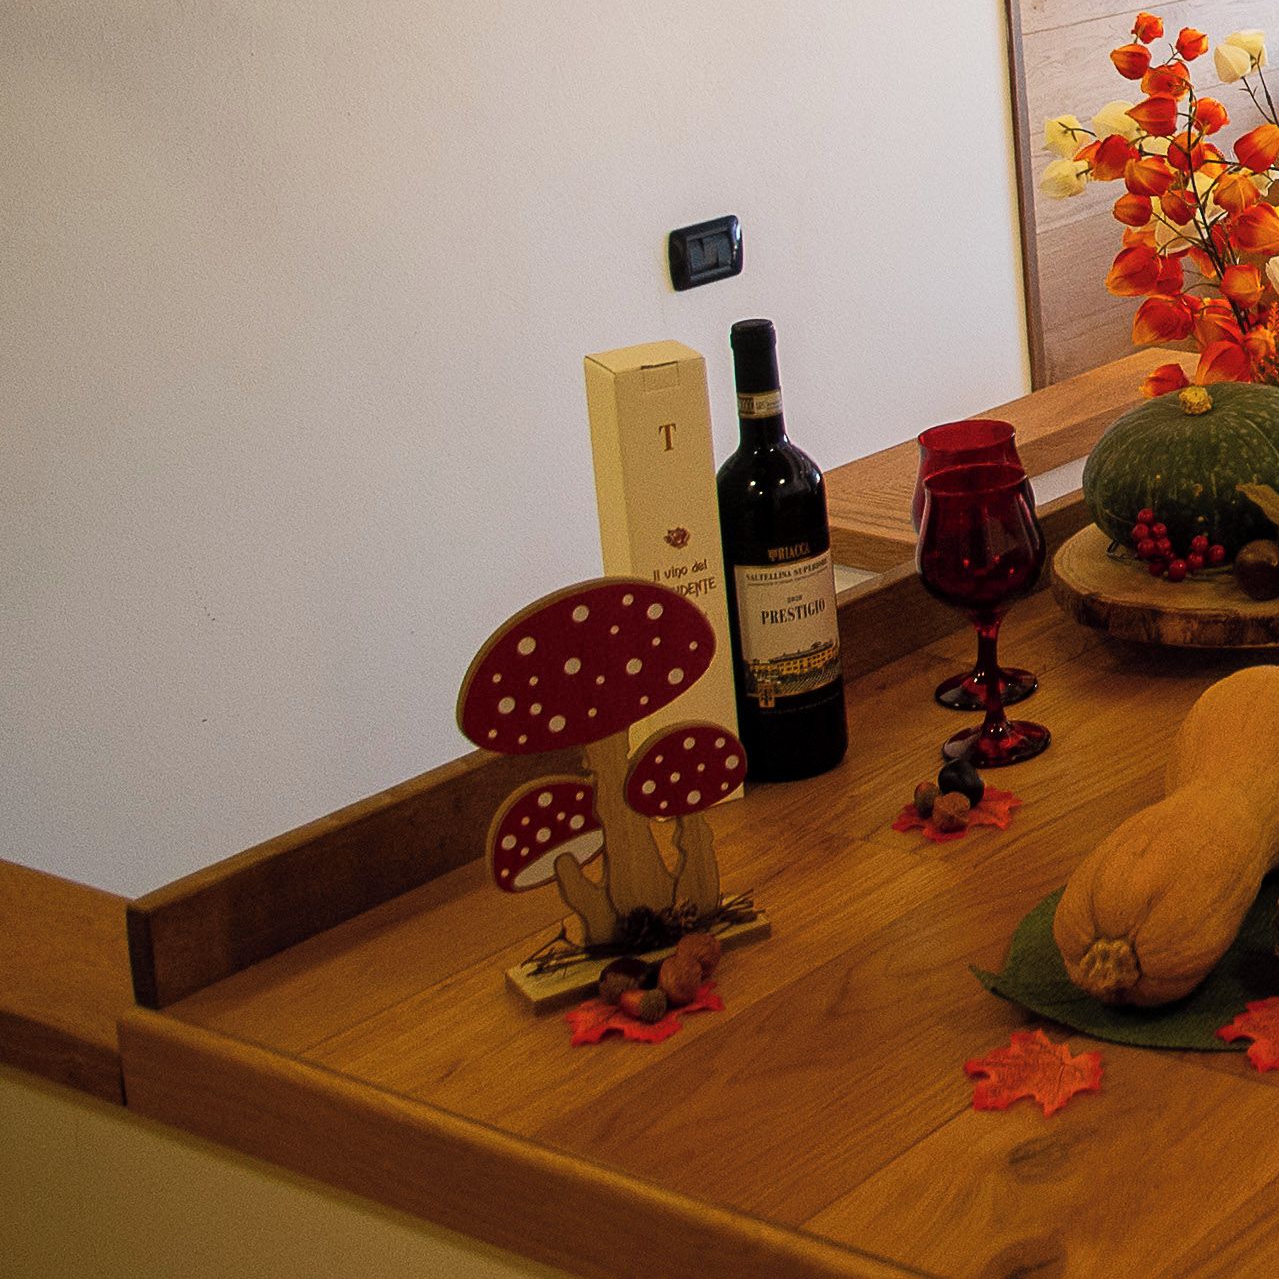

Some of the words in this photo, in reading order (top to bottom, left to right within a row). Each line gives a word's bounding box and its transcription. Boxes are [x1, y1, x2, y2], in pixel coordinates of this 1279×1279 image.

[658, 423, 677, 452] T
[664, 566, 688, 580] vino
[692, 558, 708, 573] del
[761, 597, 826, 626] PRESTIGIO
